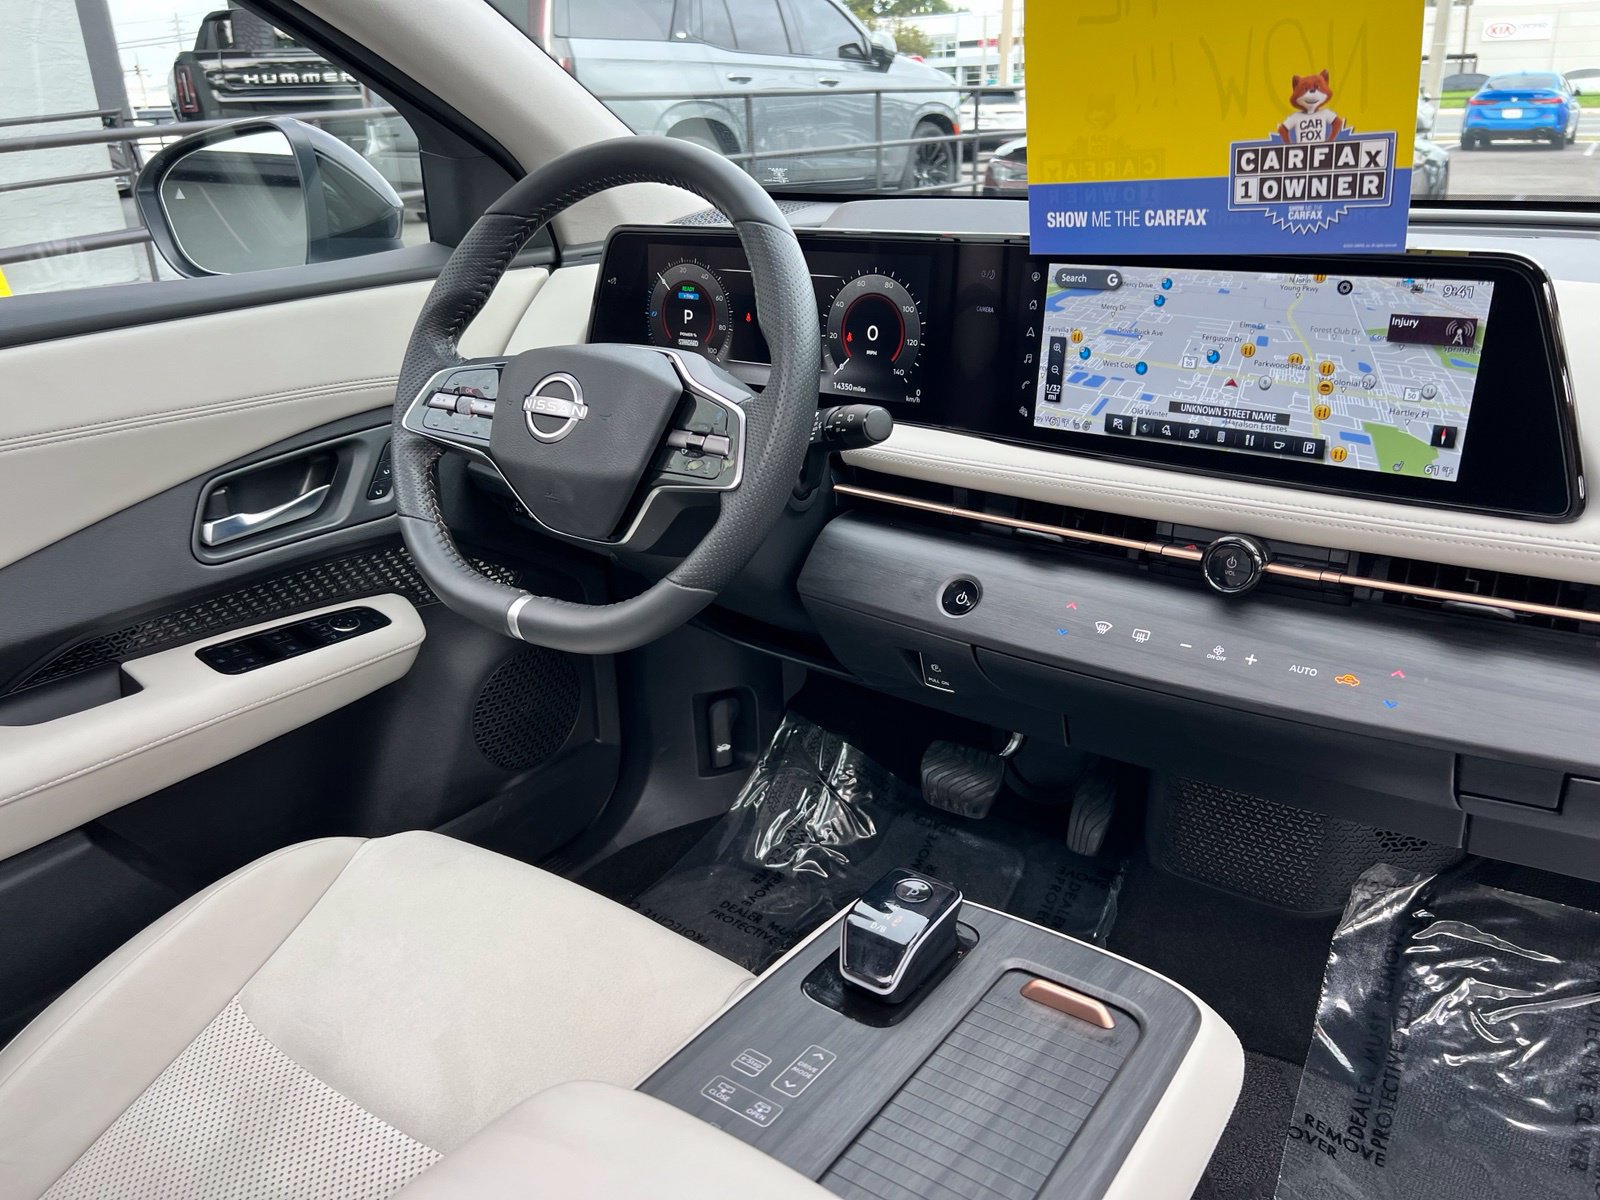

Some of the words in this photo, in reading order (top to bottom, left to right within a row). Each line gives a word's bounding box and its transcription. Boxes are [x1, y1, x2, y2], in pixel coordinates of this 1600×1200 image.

[1490, 26, 1513, 36] KIA
[242, 72, 359, 84] HUMMER
[1300, 119, 1323, 131] CAR
[1300, 130, 1322, 142] FOX
[1240, 145, 1382, 173] CARFAX
[1261, 173, 1381, 199] OWNER
[1047, 211, 1088, 228] SHOW
[1092, 211, 1111, 227] ME
[1115, 210, 1140, 227] THE
[1145, 208, 1207, 227] CARFAX
[1288, 210, 1322, 220] CARFAX
[1061, 273, 1088, 283] Search
[884, 281, 894, 289] 80
[1443, 284, 1475, 299] 9:41
[903, 305, 915, 313] 100
[976, 305, 994, 313] CAMERA
[684, 309, 693, 324] P
[1391, 317, 1420, 329] Injury
[867, 325, 879, 341] 0
[1202, 334, 1232, 343] Ferguson
[907, 339, 918, 347] 120
[1103, 360, 1120, 368] West
[893, 368, 905, 376] 140
[833, 382, 853, 391] 14350
[1046, 384, 1061, 392] 1/32
[906, 395, 921, 403] km/h
[523, 398, 584, 418] NISSAN
[1181, 404, 1222, 416] UNKNOWN
[1222, 408, 1250, 419] STREET
[1251, 410, 1277, 422] NAME
[1389, 408, 1420, 418] Hartley
[1145, 410, 1169, 419] Winter
[1260, 422, 1288, 433] Estates
[1289, 664, 1318, 677] AUTO
[719, 899, 764, 926] DEALER
[708, 907, 780, 947] PROTECTIVE
[791, 1065, 814, 1080] MODE
[797, 1060, 820, 1074] DRIVE
[708, 1088, 731, 1102] CLOSE
[1371, 1046, 1401, 1151] PROTECTIVE
[1347, 1074, 1376, 1140] DEALER
[745, 1107, 767, 1121] OPEN
[1304, 1112, 1387, 1168] REMOVE
